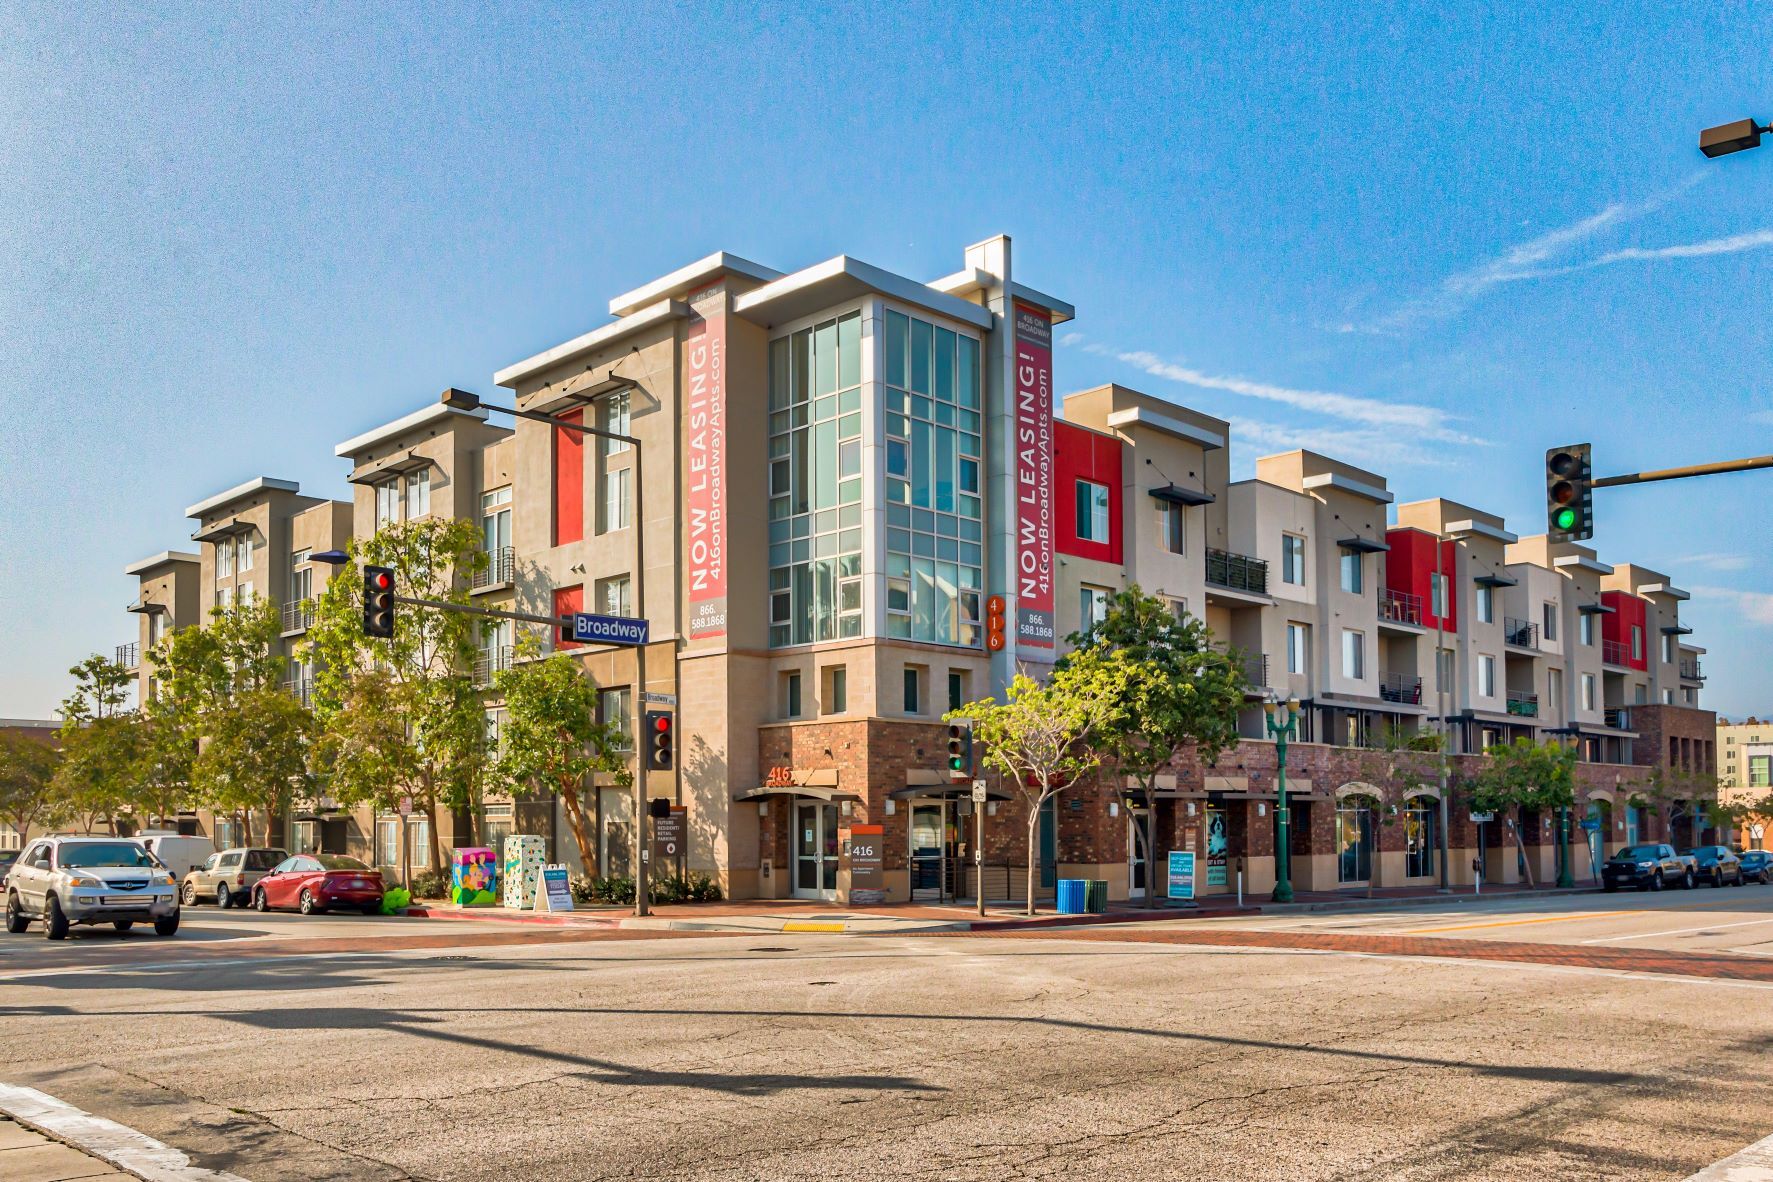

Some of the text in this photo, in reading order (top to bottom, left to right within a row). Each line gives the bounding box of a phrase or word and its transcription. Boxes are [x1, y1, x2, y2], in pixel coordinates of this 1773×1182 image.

[1017, 320, 1050, 338] BROADWAY
[1034, 319, 1044, 329] ON
[1019, 352, 1036, 505] LEASING!
[691, 333, 708, 591] NOW LEASING!
[710, 338, 722, 580] 416onBroadwayApts.com
[1038, 368, 1050, 594] 416onBroadwayApts.com
[1020, 517, 1037, 599] NOW
[700, 604, 716, 616] 866.
[691, 614, 725, 630] 588.1868
[1029, 614, 1045, 625] 866.
[577, 616, 646, 643] Broadway
[1020, 625, 1053, 638] 588.1868
[648, 693, 668, 703] Broadway
[768, 766, 792, 781] 416
[852, 846, 873, 856] 416
